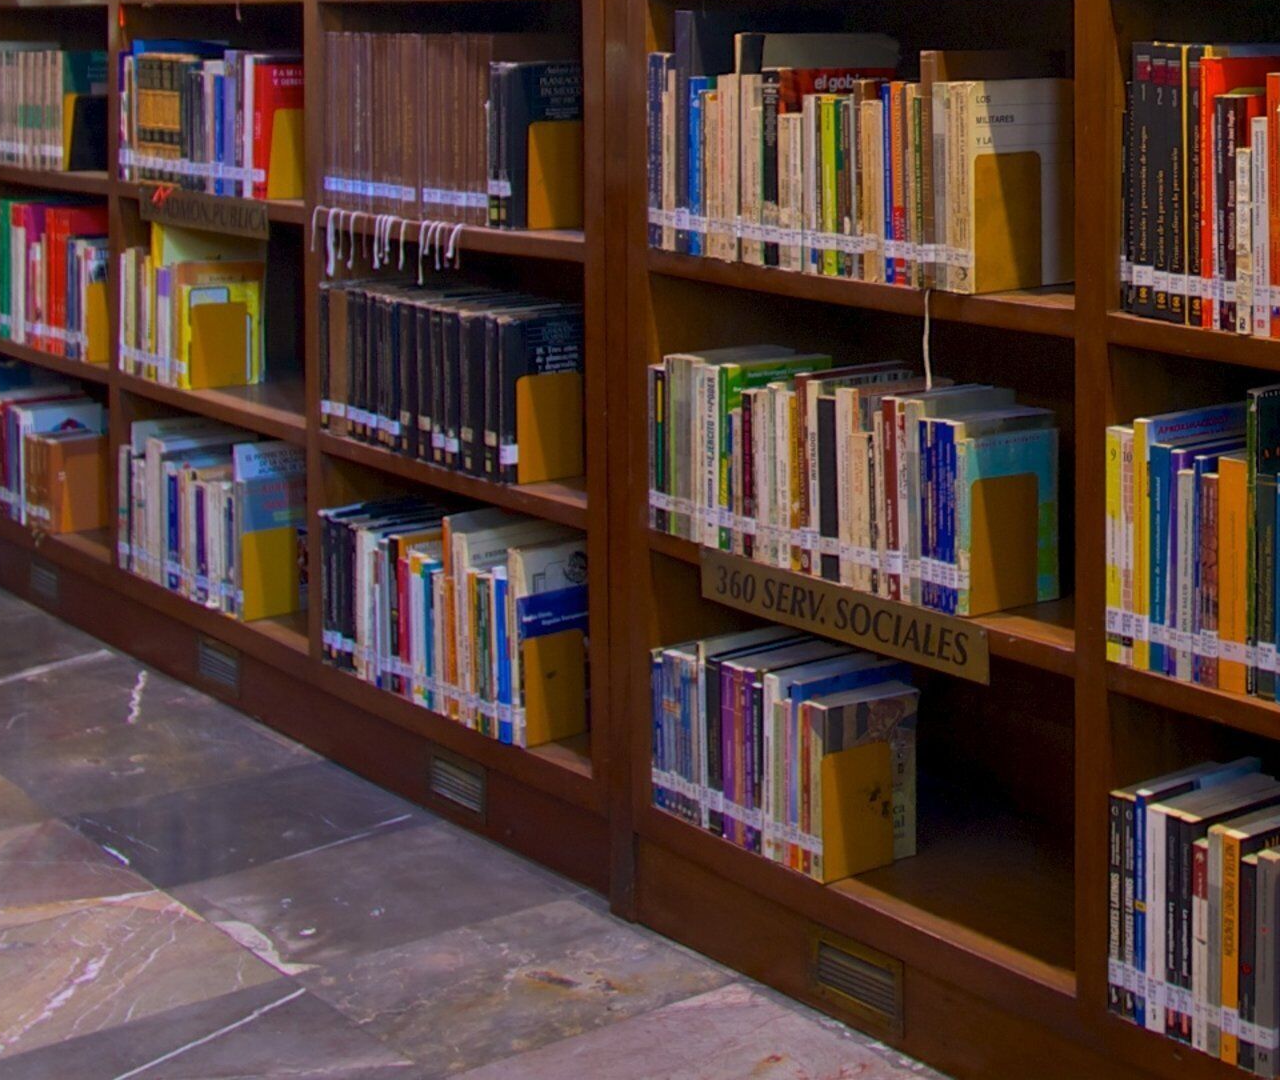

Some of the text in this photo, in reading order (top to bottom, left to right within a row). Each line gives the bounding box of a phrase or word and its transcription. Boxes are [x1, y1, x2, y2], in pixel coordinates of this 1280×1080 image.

[814, 74, 826, 90] el
[976, 115, 1015, 124] MILITARES
[716, 565, 969, 666] 360 SERV. SOCIALES
